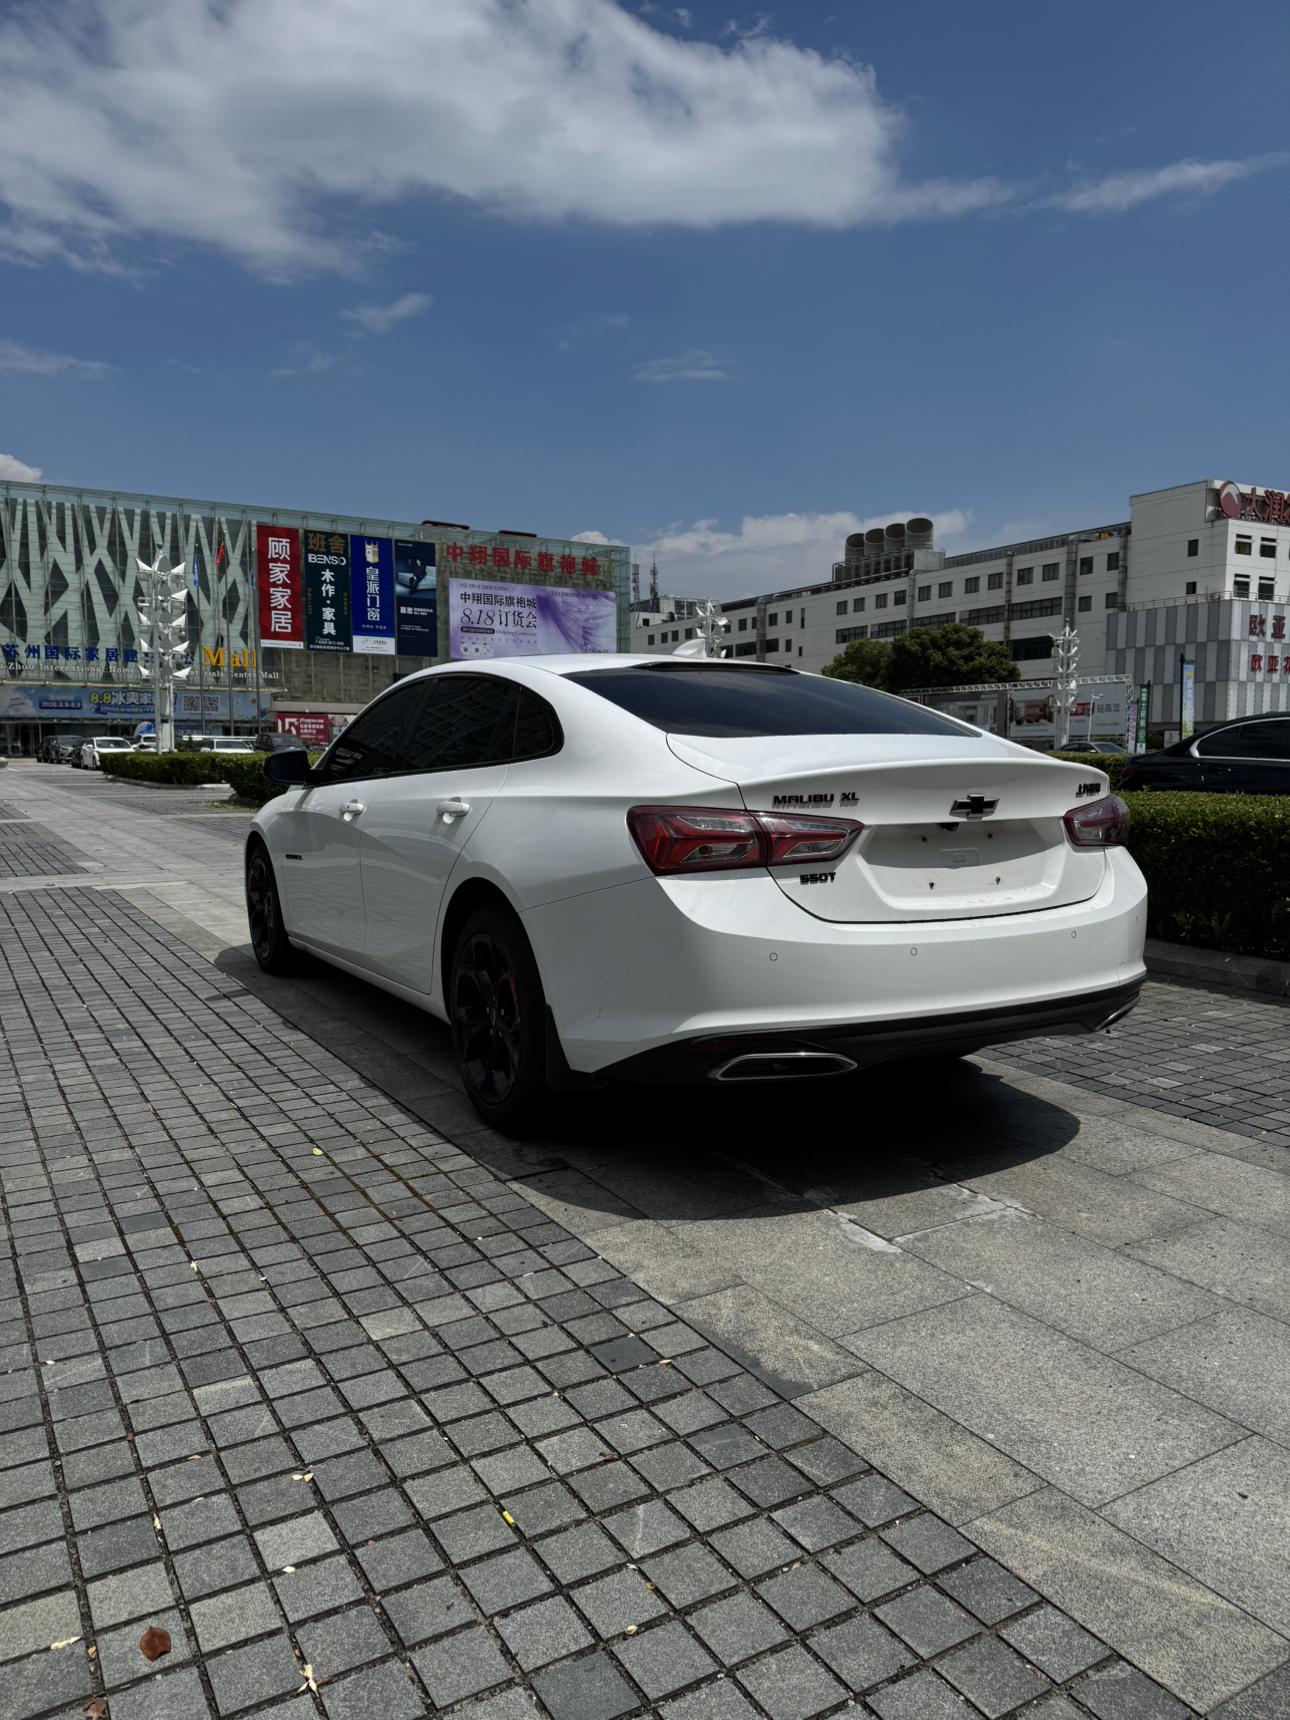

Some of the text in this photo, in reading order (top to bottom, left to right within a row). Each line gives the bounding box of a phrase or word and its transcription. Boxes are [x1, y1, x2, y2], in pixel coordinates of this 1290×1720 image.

[308, 553, 347, 566] BENSO
[446, 542, 599, 577] 中翔国际旗袍城
[268, 537, 292, 633] 顾家家居
[365, 566, 380, 621] 皇派门窗
[460, 591, 537, 609] 中翔国际旗袍城
[1248, 613, 1287, 640] 欧亚
[203, 646, 257, 668] Mall
[8, 662, 35, 671] Zhou
[40, 664, 104, 673] International
[260, 671, 280, 680] Mall
[773, 791, 860, 806] MALIBU XL
[799, 872, 836, 885] 550T
